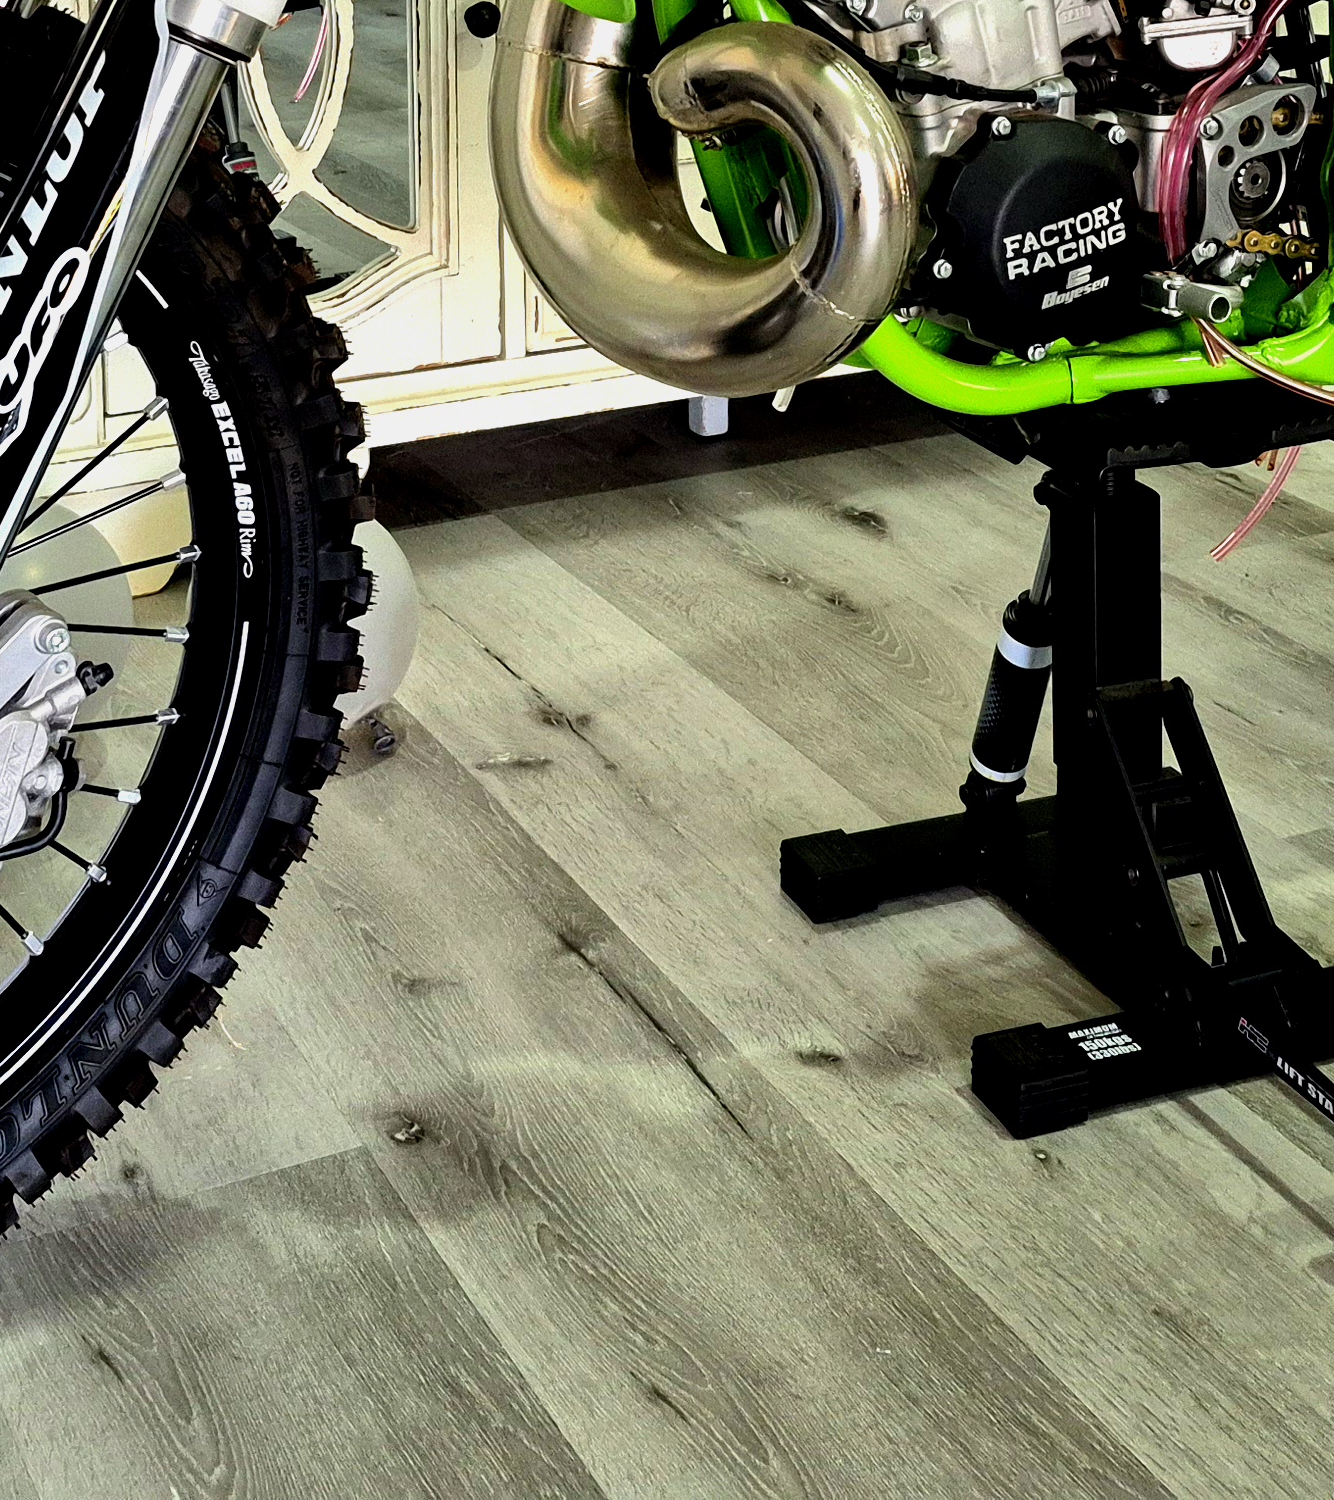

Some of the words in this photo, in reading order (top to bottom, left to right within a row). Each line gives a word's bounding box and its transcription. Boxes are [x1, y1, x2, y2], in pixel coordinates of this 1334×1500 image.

[1003, 198, 1123, 258] FACTORY
[1007, 222, 1126, 280] RACING
[1041, 276, 1109, 310] Boyesen
[188, 341, 220, 400] Takasago
[211, 400, 246, 479] EXCEL
[233, 482, 255, 525] A60
[239, 527, 256, 578] Rim
[1078, 1034, 1132, 1051] 150kgs
[1276, 1056, 1305, 1087] LIFT
